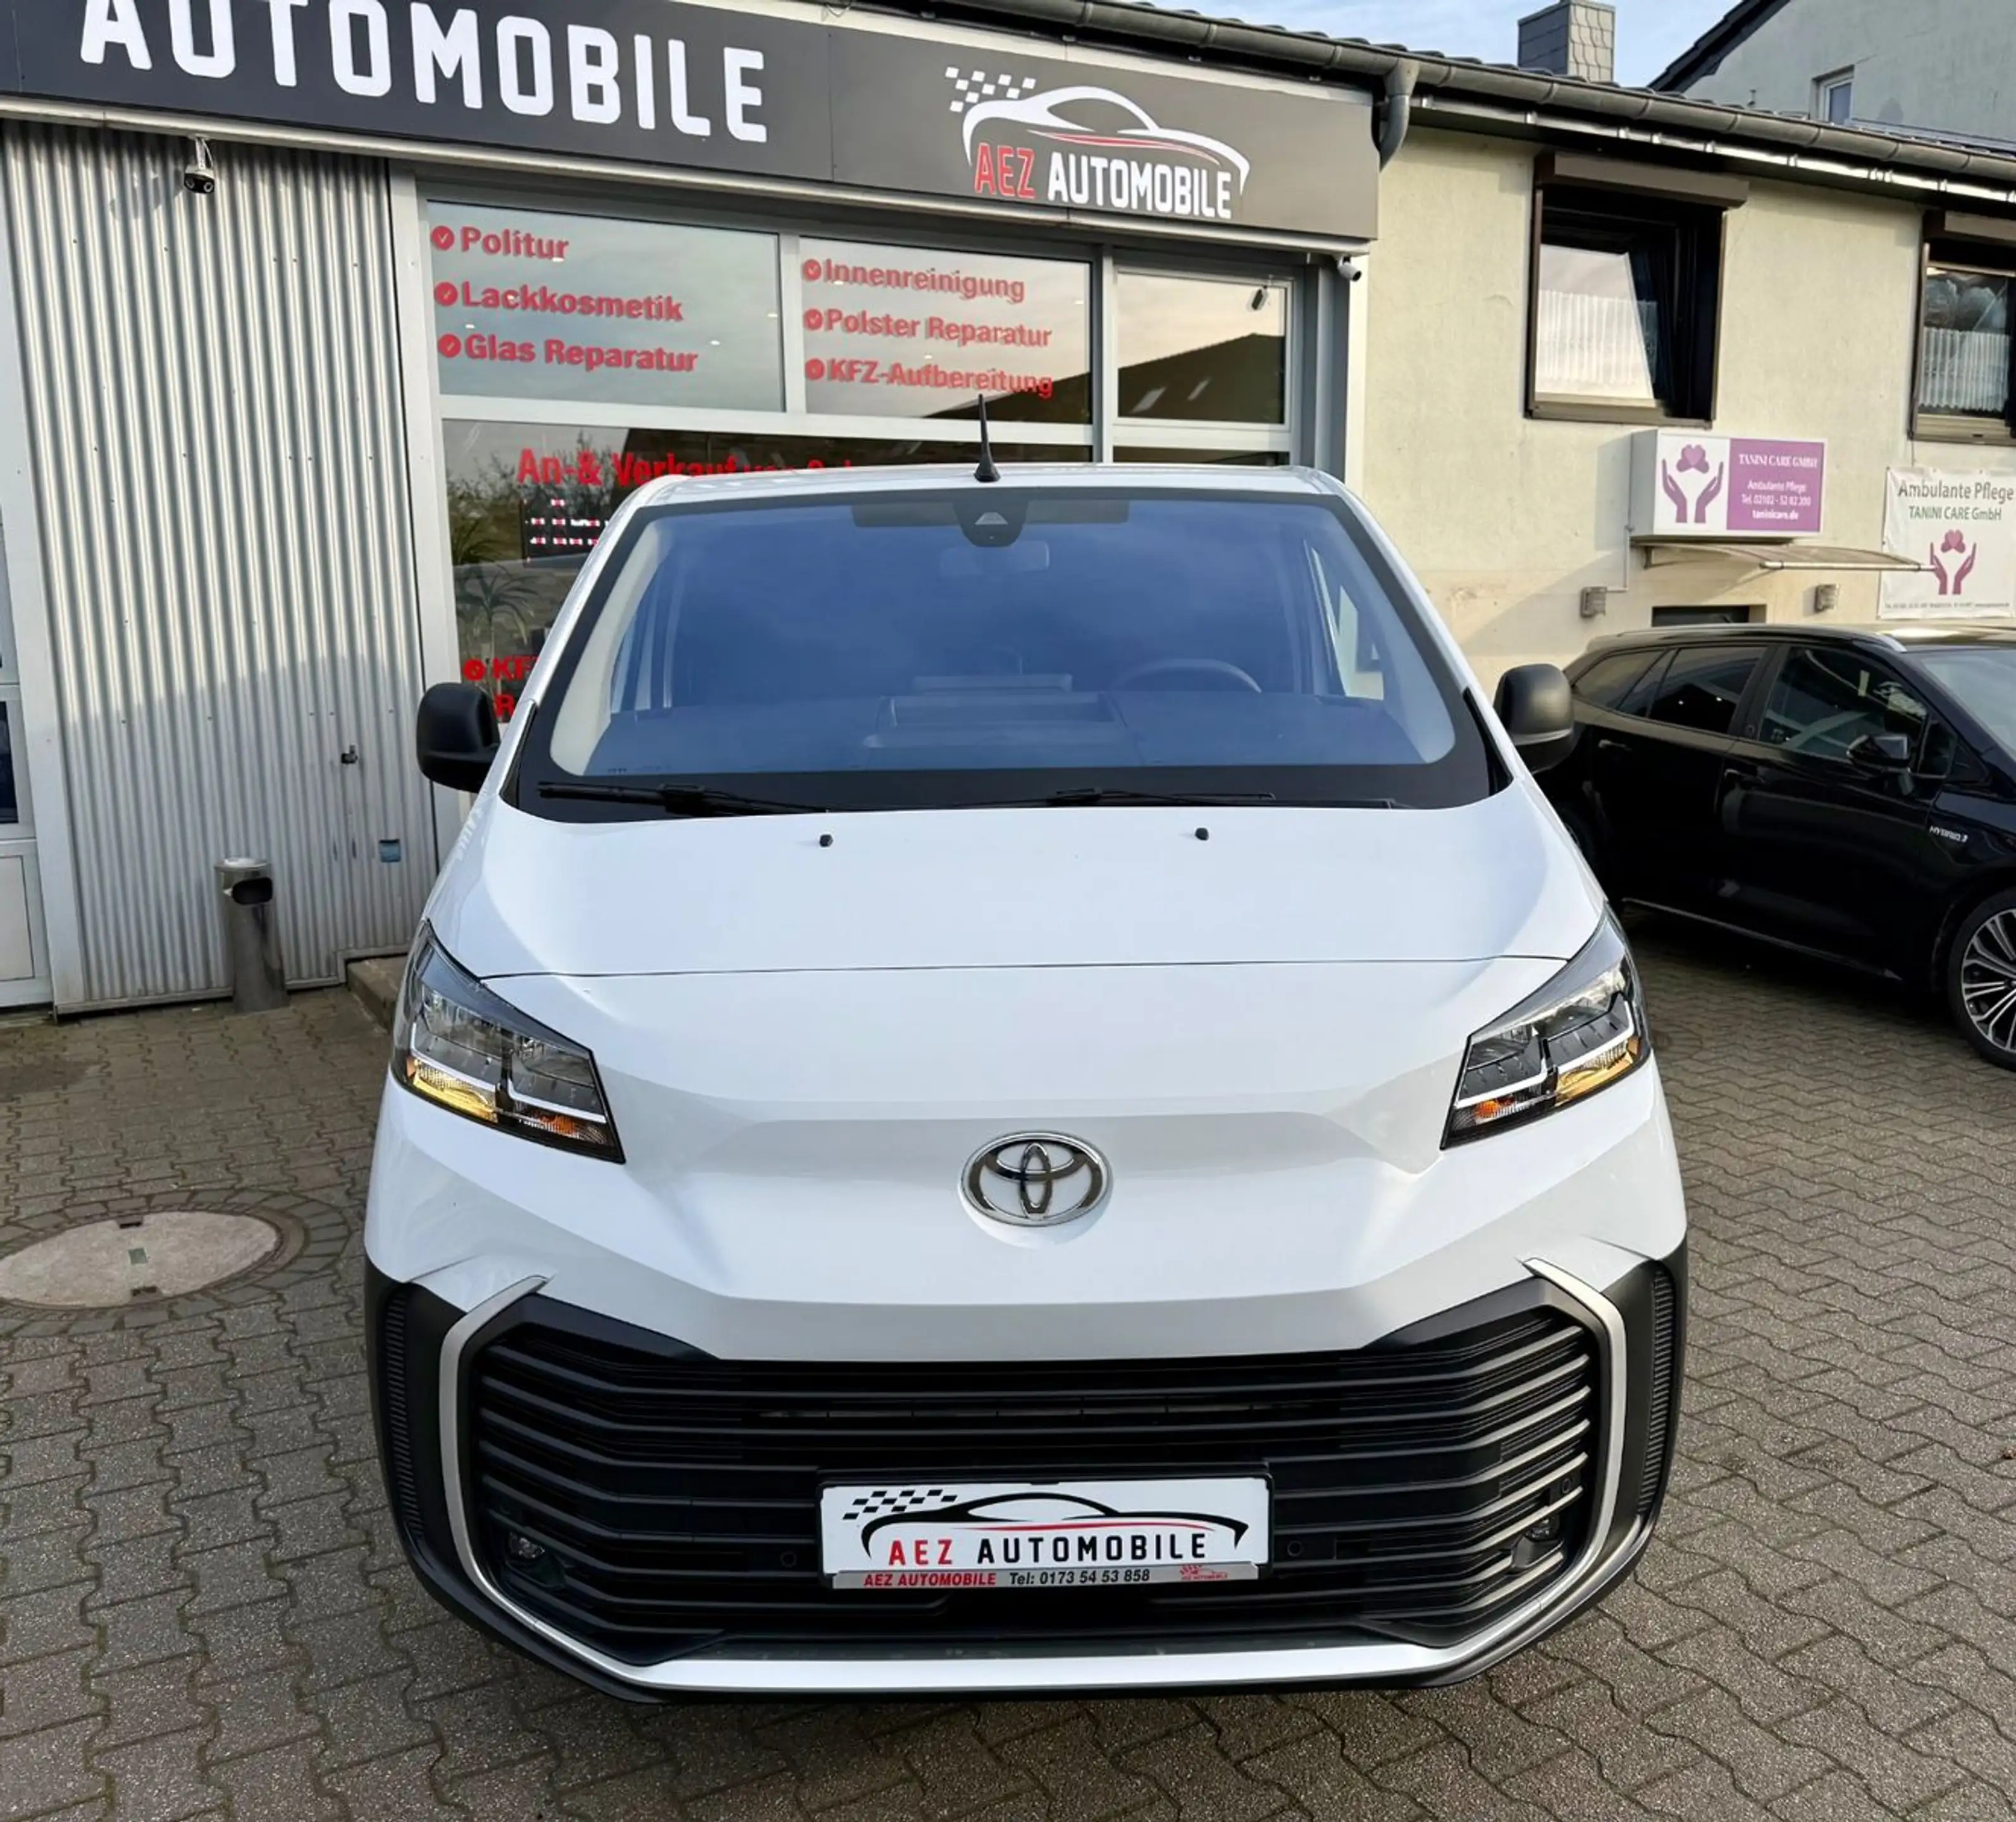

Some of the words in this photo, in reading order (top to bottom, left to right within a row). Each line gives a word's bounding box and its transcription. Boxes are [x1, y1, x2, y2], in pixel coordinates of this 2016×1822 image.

[80, 0, 769, 142] AUTOMOBILE
[974, 142, 1036, 199] AEZ
[1048, 151, 1232, 220] AUTOMOBILE
[461, 226, 569, 259] Politur
[826, 259, 1025, 304] Innenreinigung
[462, 281, 683, 322] Lackkosmetik
[826, 308, 920, 338] Polster
[927, 316, 1052, 348] Reparatur
[465, 333, 536, 363] Glas
[545, 339, 698, 372] Reparatur
[828, 357, 1054, 400] KFZ-Aufbereitung
[1898, 479, 1972, 499] Ambulante
[1974, 481, 2014, 505] Pflege
[1908, 505, 1942, 519] TANINI
[1944, 506, 1971, 520] CARE
[1972, 507, 2002, 521] GmbH
[889, 1539, 953, 1566] AEZ
[977, 1533, 1206, 1565] AUTOMOBILE
[864, 1574, 893, 1587] AEZ
[898, 1573, 996, 1587] AUTOMOBILE
[1009, 1572, 1036, 1586] Tel:
[1039, 1571, 1075, 1585] 0173
[1079, 1571, 1098, 1583] 54
[1101, 1570, 1120, 1583] 53
[1123, 1569, 1151, 1582] 858
